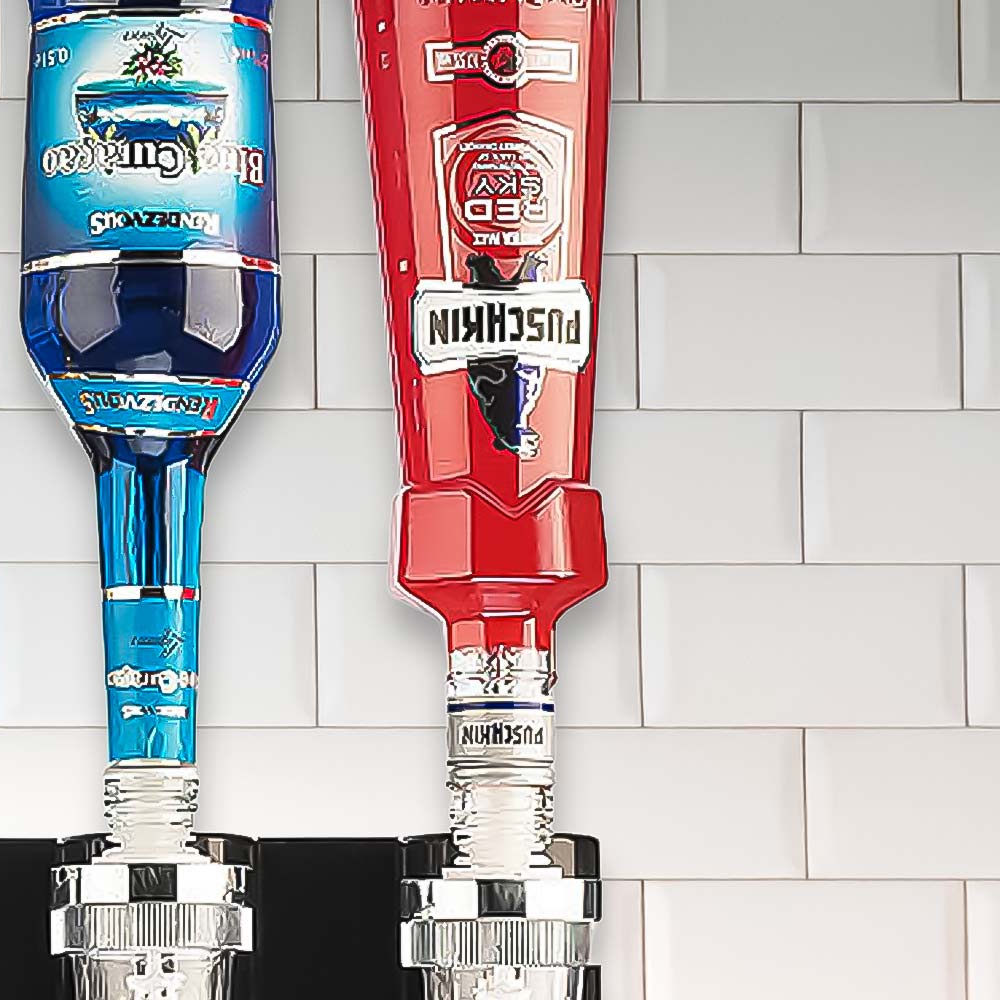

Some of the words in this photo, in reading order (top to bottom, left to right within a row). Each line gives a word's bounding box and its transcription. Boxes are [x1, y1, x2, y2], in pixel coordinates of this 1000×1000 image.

[473, 176, 544, 197] SKY
[88, 209, 221, 237] RENDEZVOUS
[465, 198, 550, 222] RED
[428, 302, 582, 345] PUSCHKIN
[78, 390, 220, 420] RENDEZVOUS
[461, 722, 544, 745] PUSCHKIN
